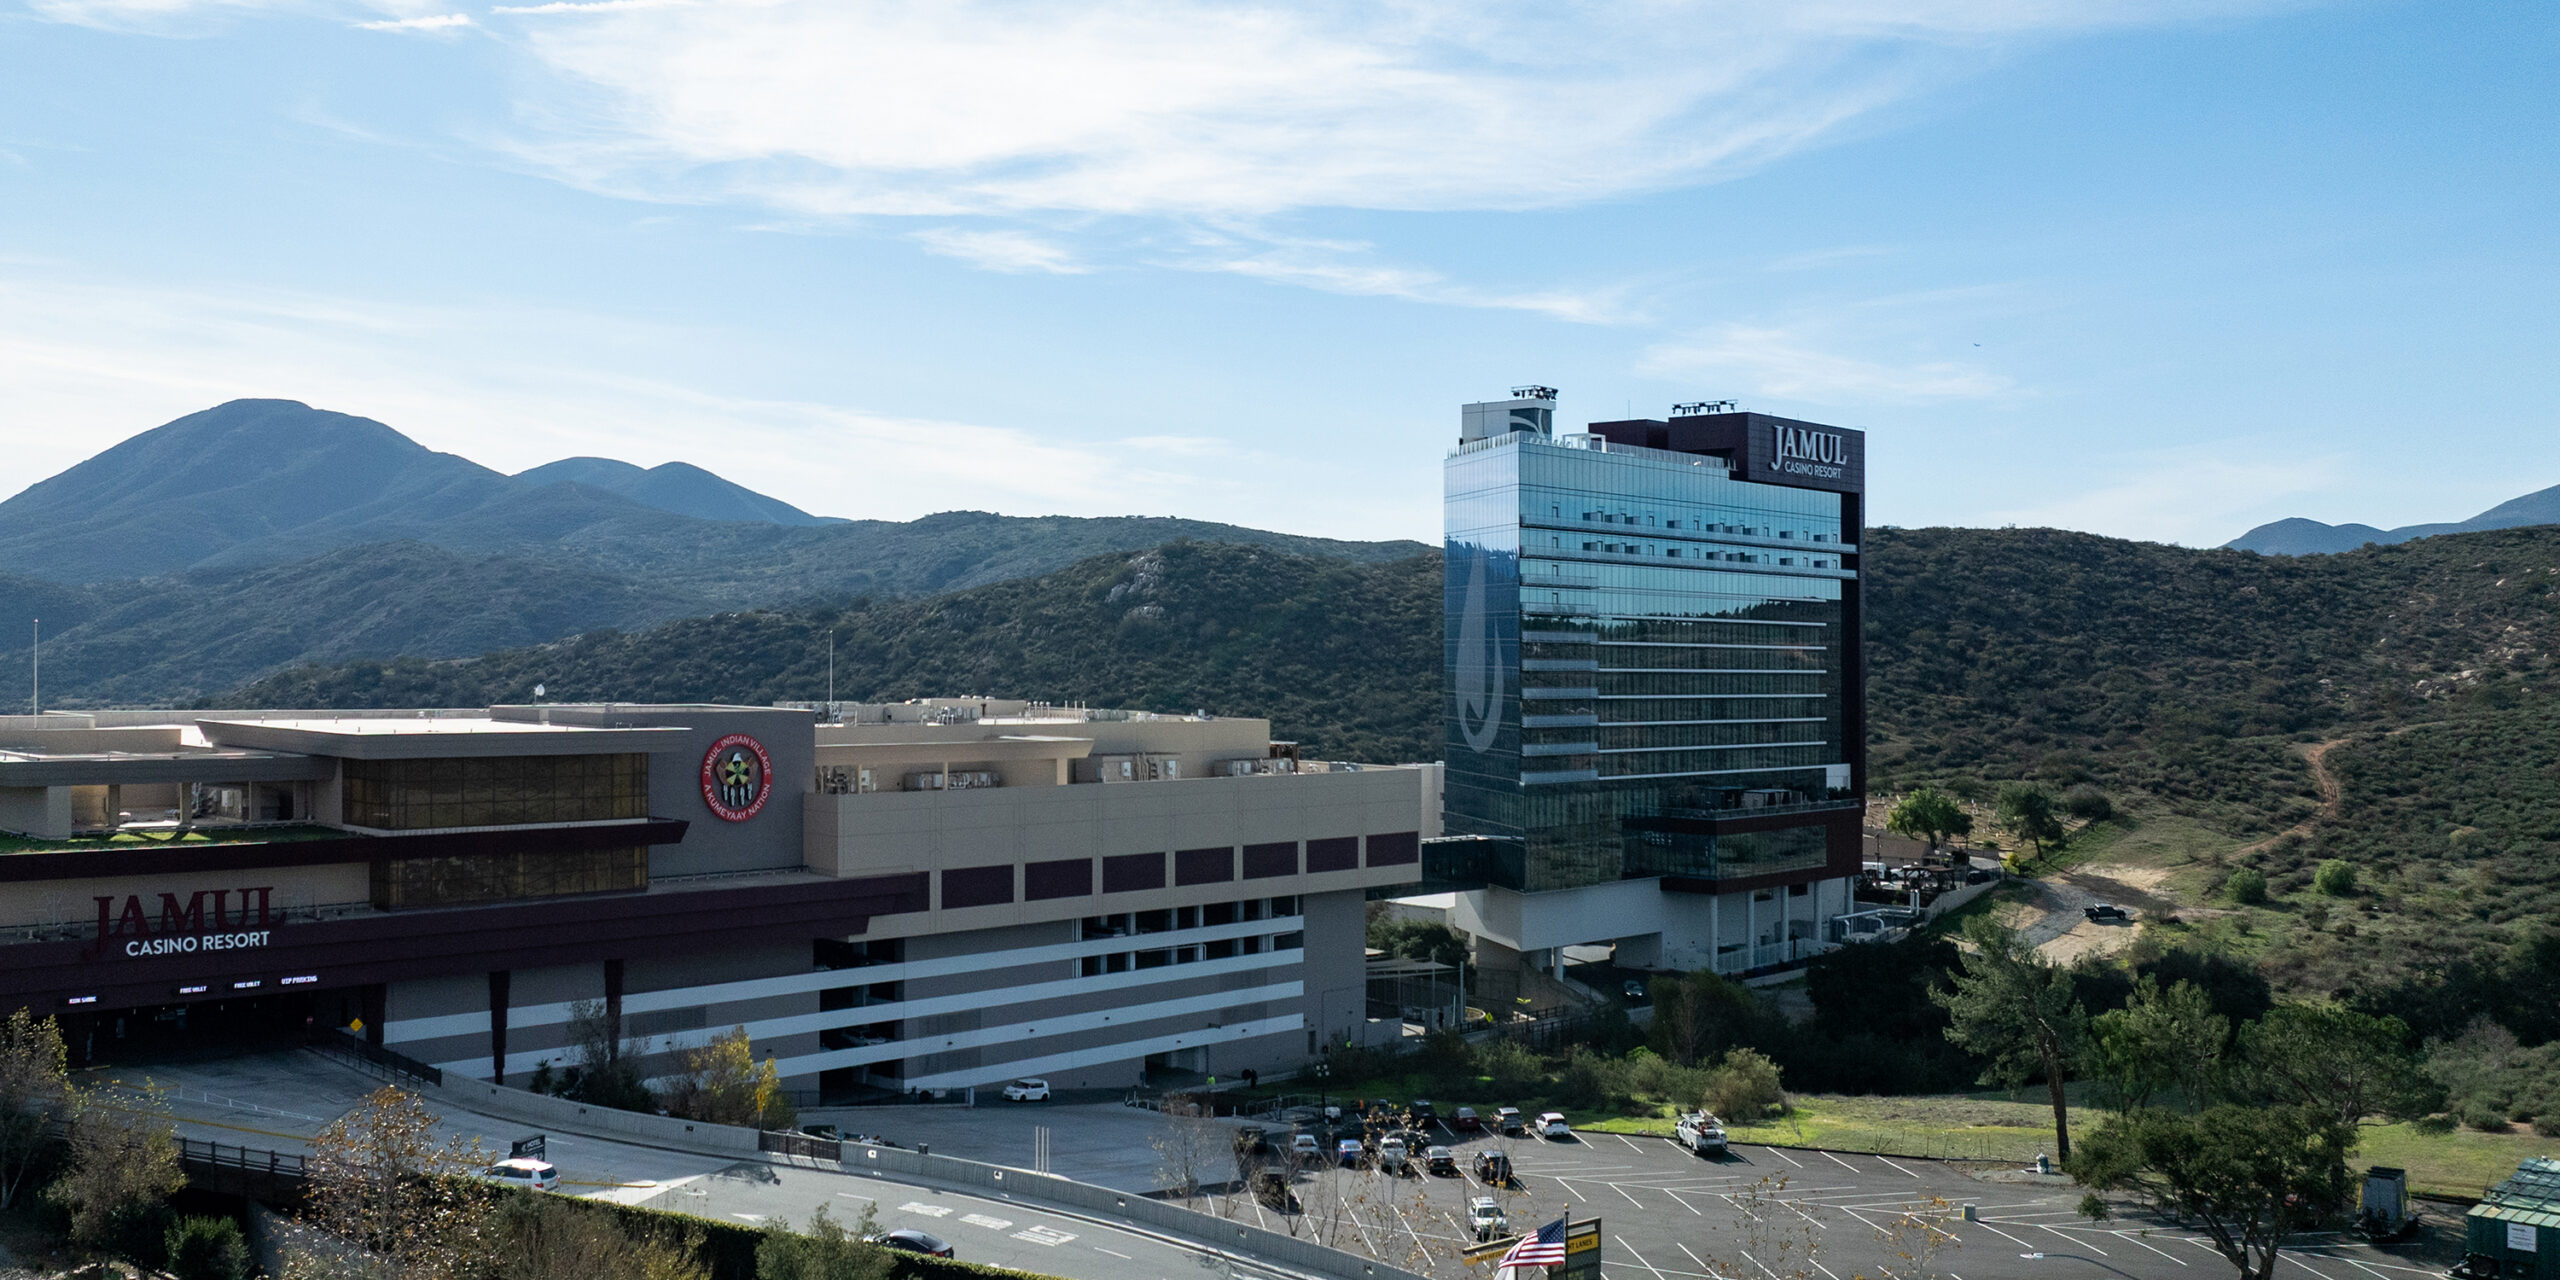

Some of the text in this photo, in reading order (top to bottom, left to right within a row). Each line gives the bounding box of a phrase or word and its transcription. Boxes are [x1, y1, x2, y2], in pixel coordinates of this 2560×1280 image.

[1770, 425, 1848, 470] JAMUL
[1784, 461, 1842, 479] CASINO RESORT
[704, 735, 771, 776] JAMUL INDIAN VILLAGE
[704, 783, 770, 819] A KUMEYAAY NATION
[82, 887, 288, 961] JAMUL
[126, 931, 270, 957] CASINO RESORT
